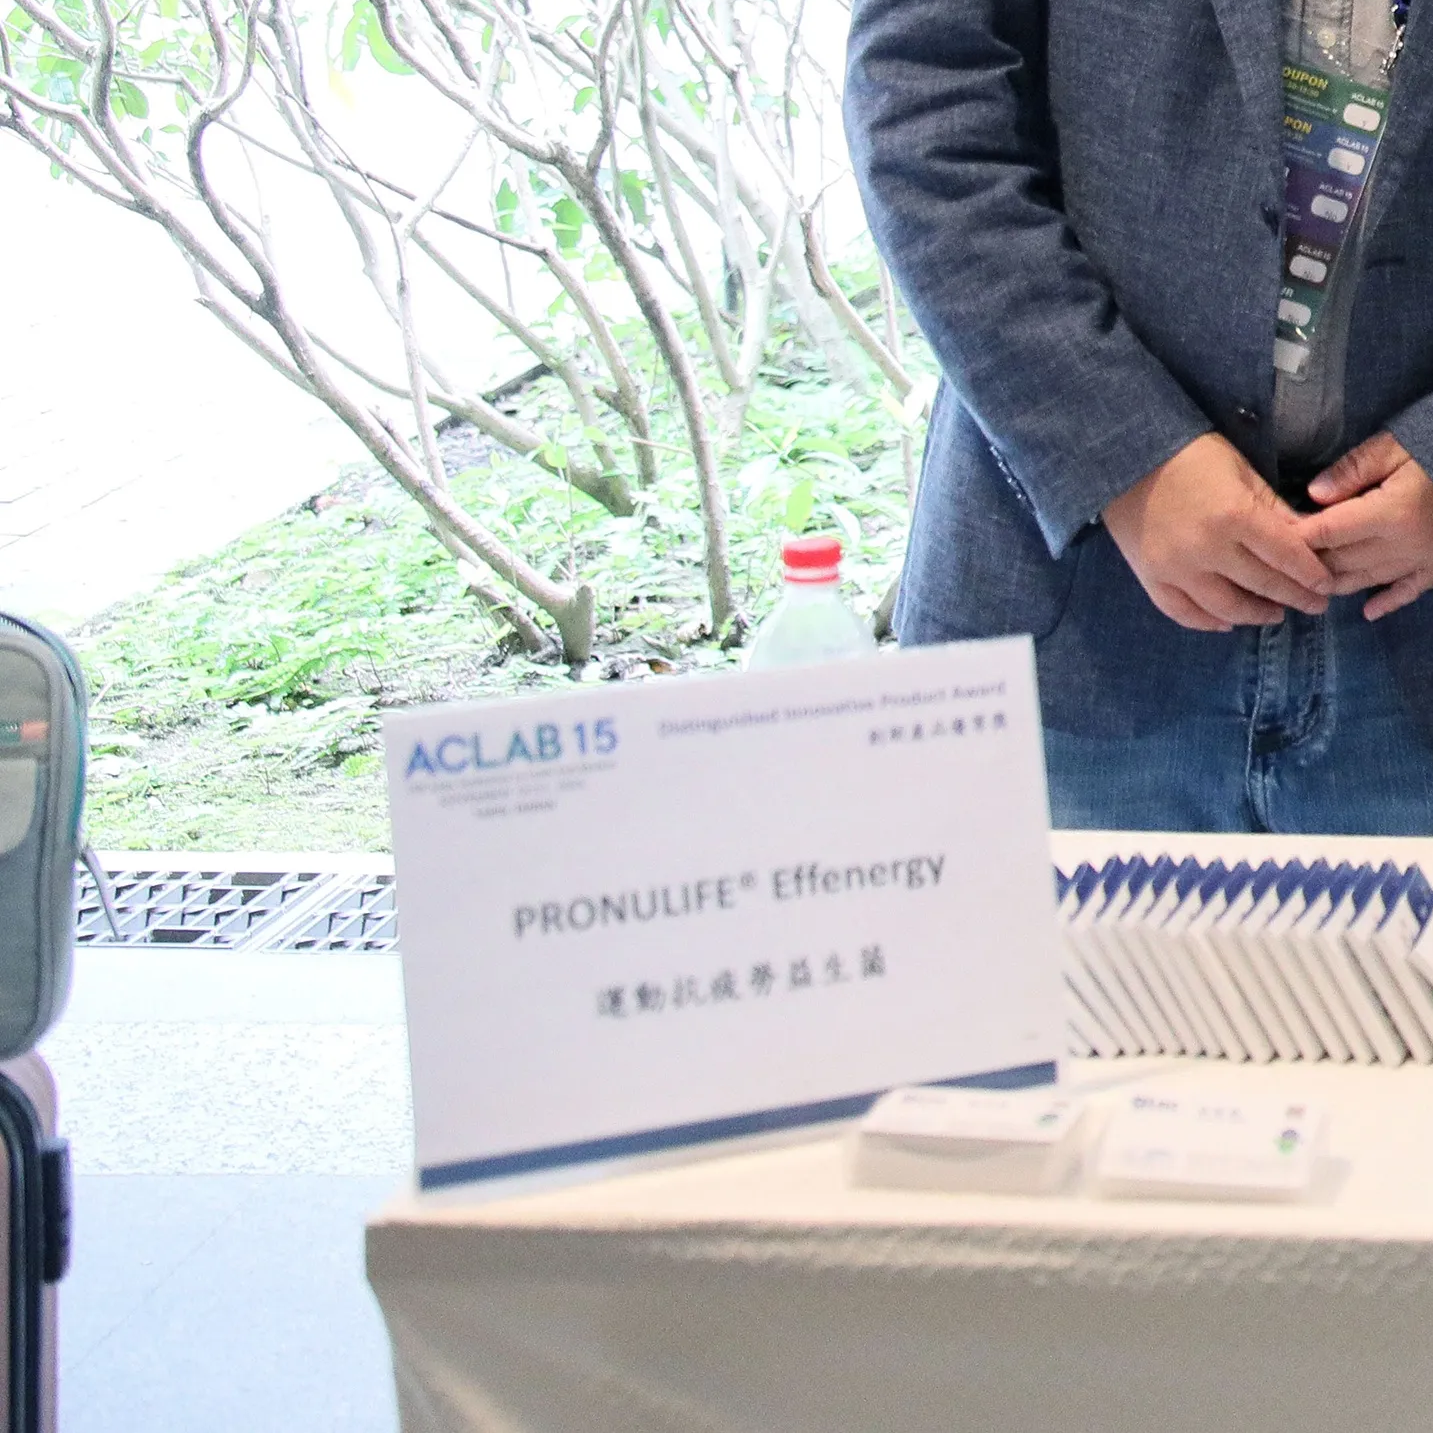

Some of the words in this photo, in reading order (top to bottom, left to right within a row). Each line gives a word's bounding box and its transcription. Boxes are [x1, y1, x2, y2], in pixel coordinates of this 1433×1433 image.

[404, 722, 564, 779] ACLAB
[573, 716, 619, 756] 15
[771, 852, 947, 902] Effenergy
